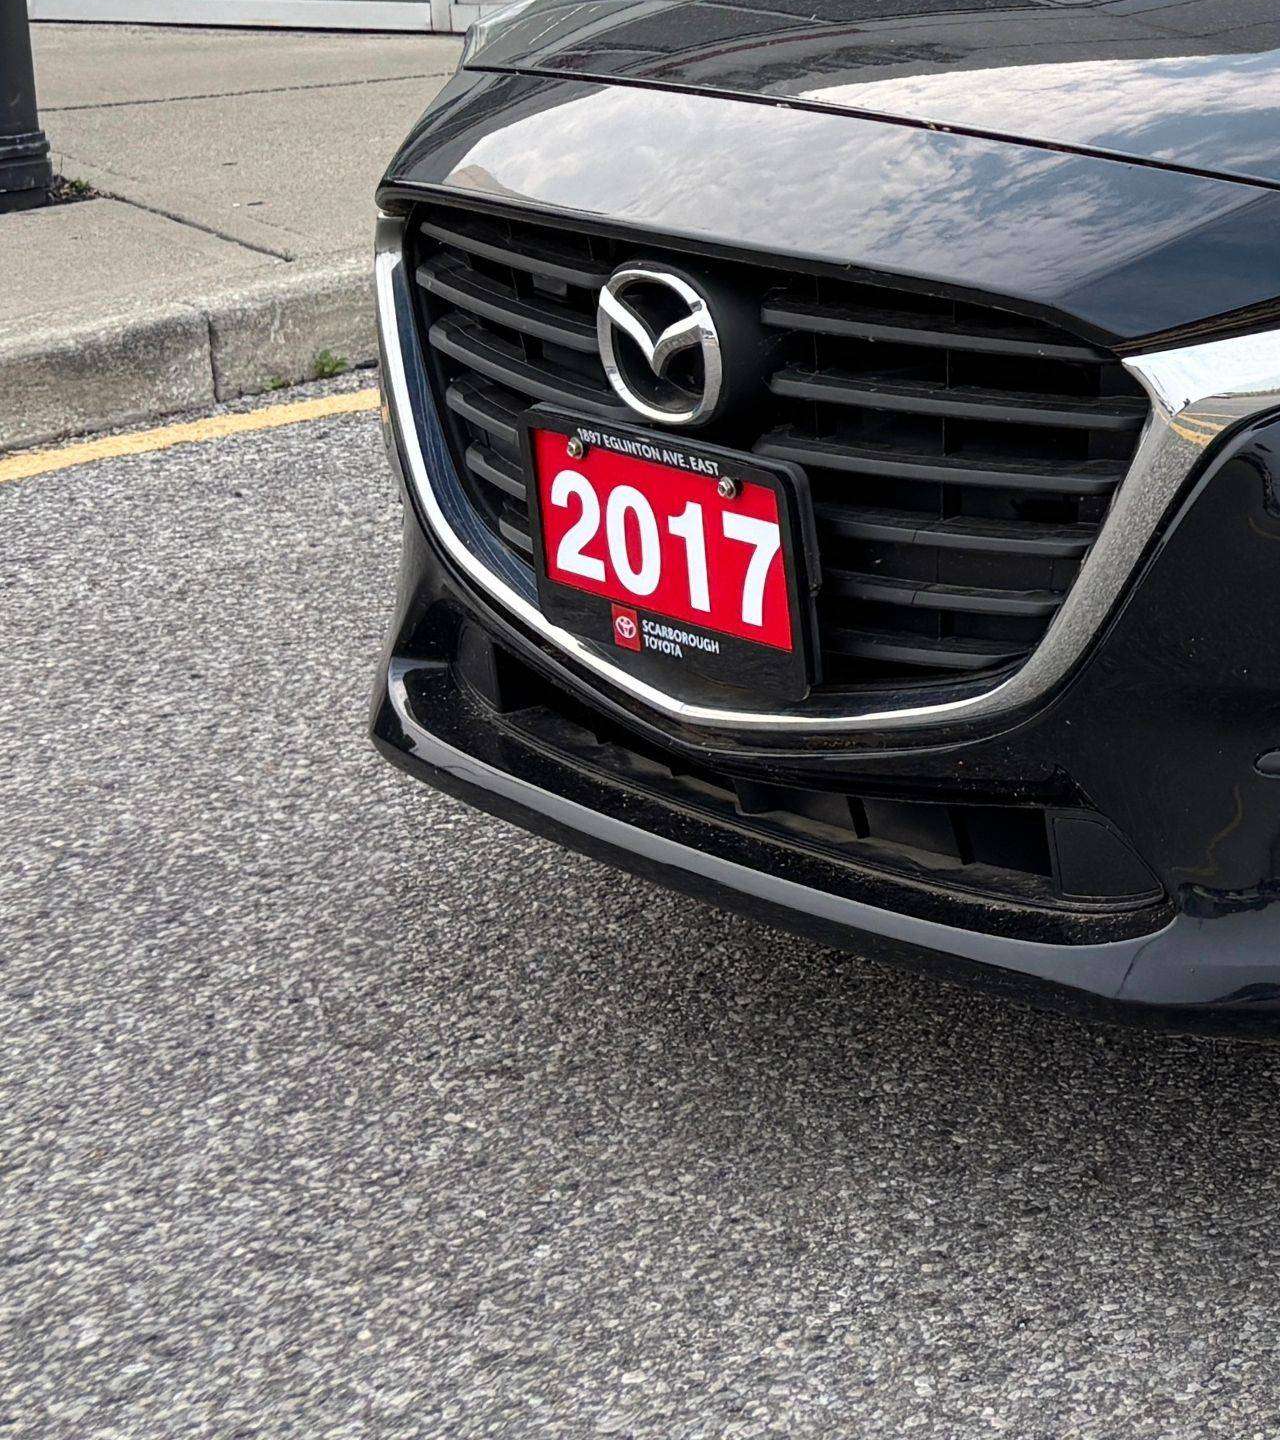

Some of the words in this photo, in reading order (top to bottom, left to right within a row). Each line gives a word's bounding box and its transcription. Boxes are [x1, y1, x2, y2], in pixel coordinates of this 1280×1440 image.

[577, 428, 602, 444] 1897
[603, 434, 661, 461] EGLINTON
[689, 456, 720, 476] EAST
[551, 469, 781, 627] 2017
[642, 619, 720, 654] SCARBOROUGH
[643, 634, 683, 658] TOYOTA
